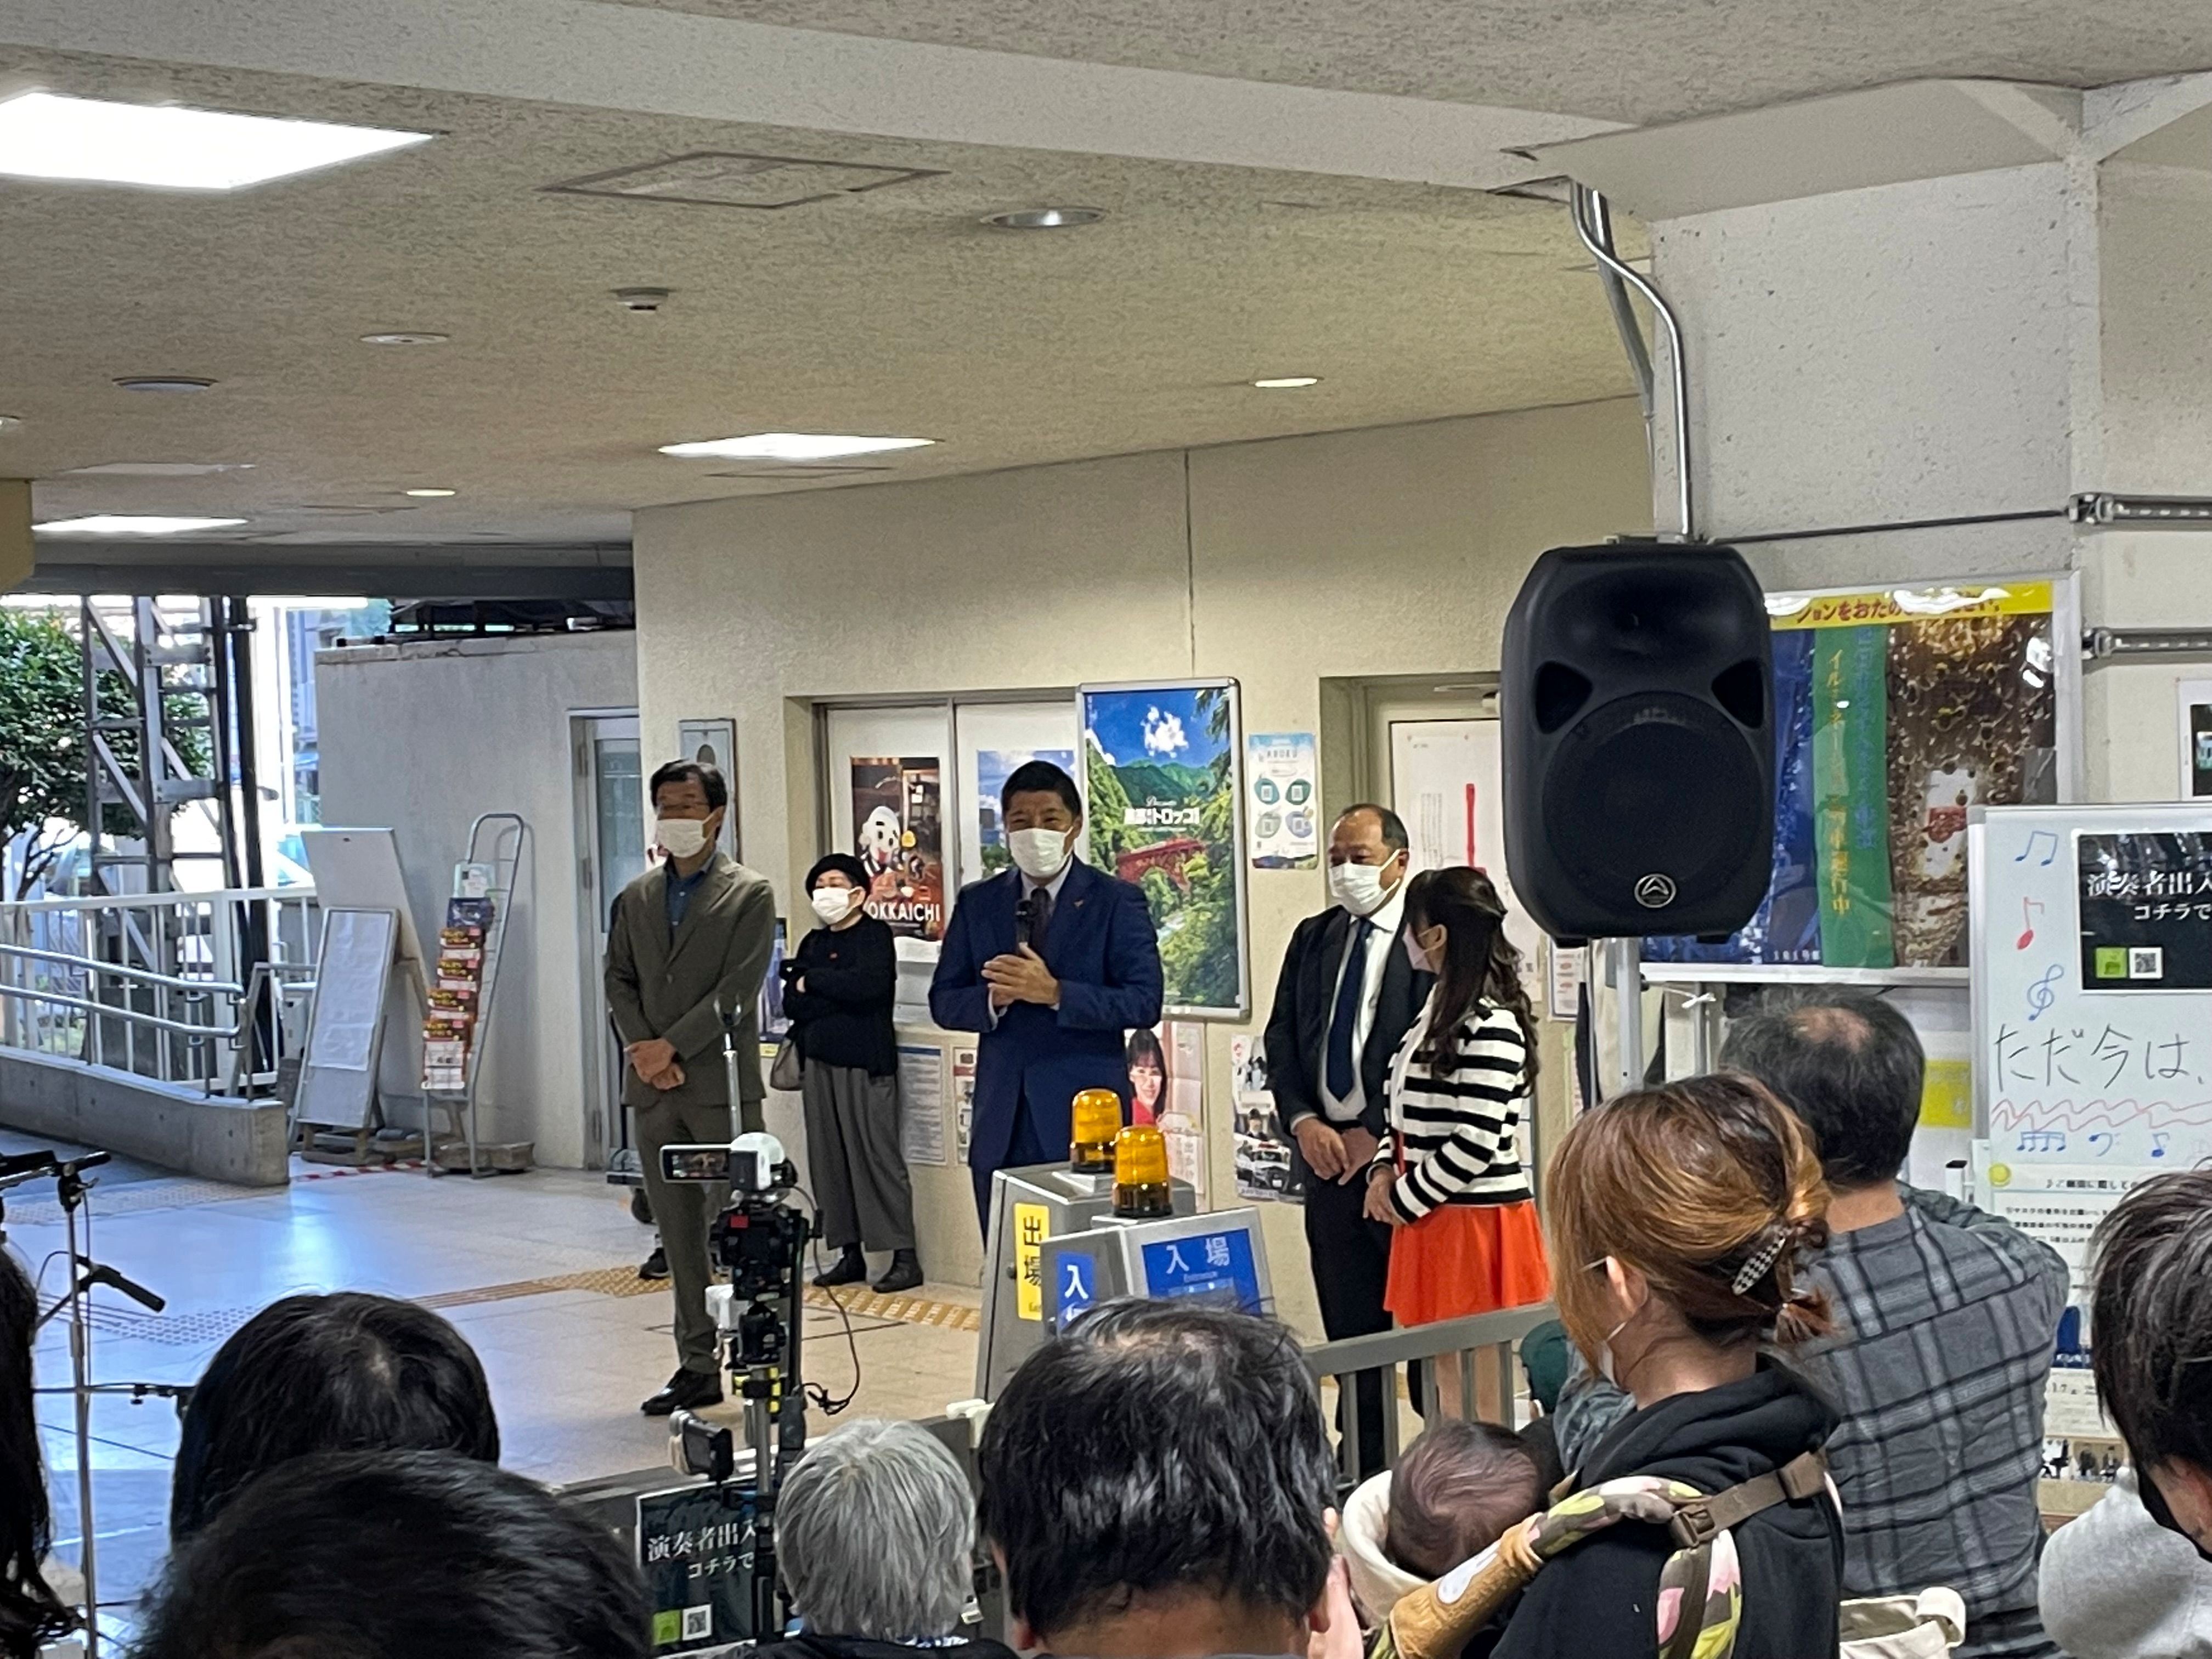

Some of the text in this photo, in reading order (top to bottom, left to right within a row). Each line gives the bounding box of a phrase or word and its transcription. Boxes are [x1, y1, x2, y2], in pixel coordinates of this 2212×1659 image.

[1994, 1023, 2204, 1093] ただ今は、
[1166, 1236, 1230, 1274] 入場
[688, 1552, 755, 1579] コチラで
